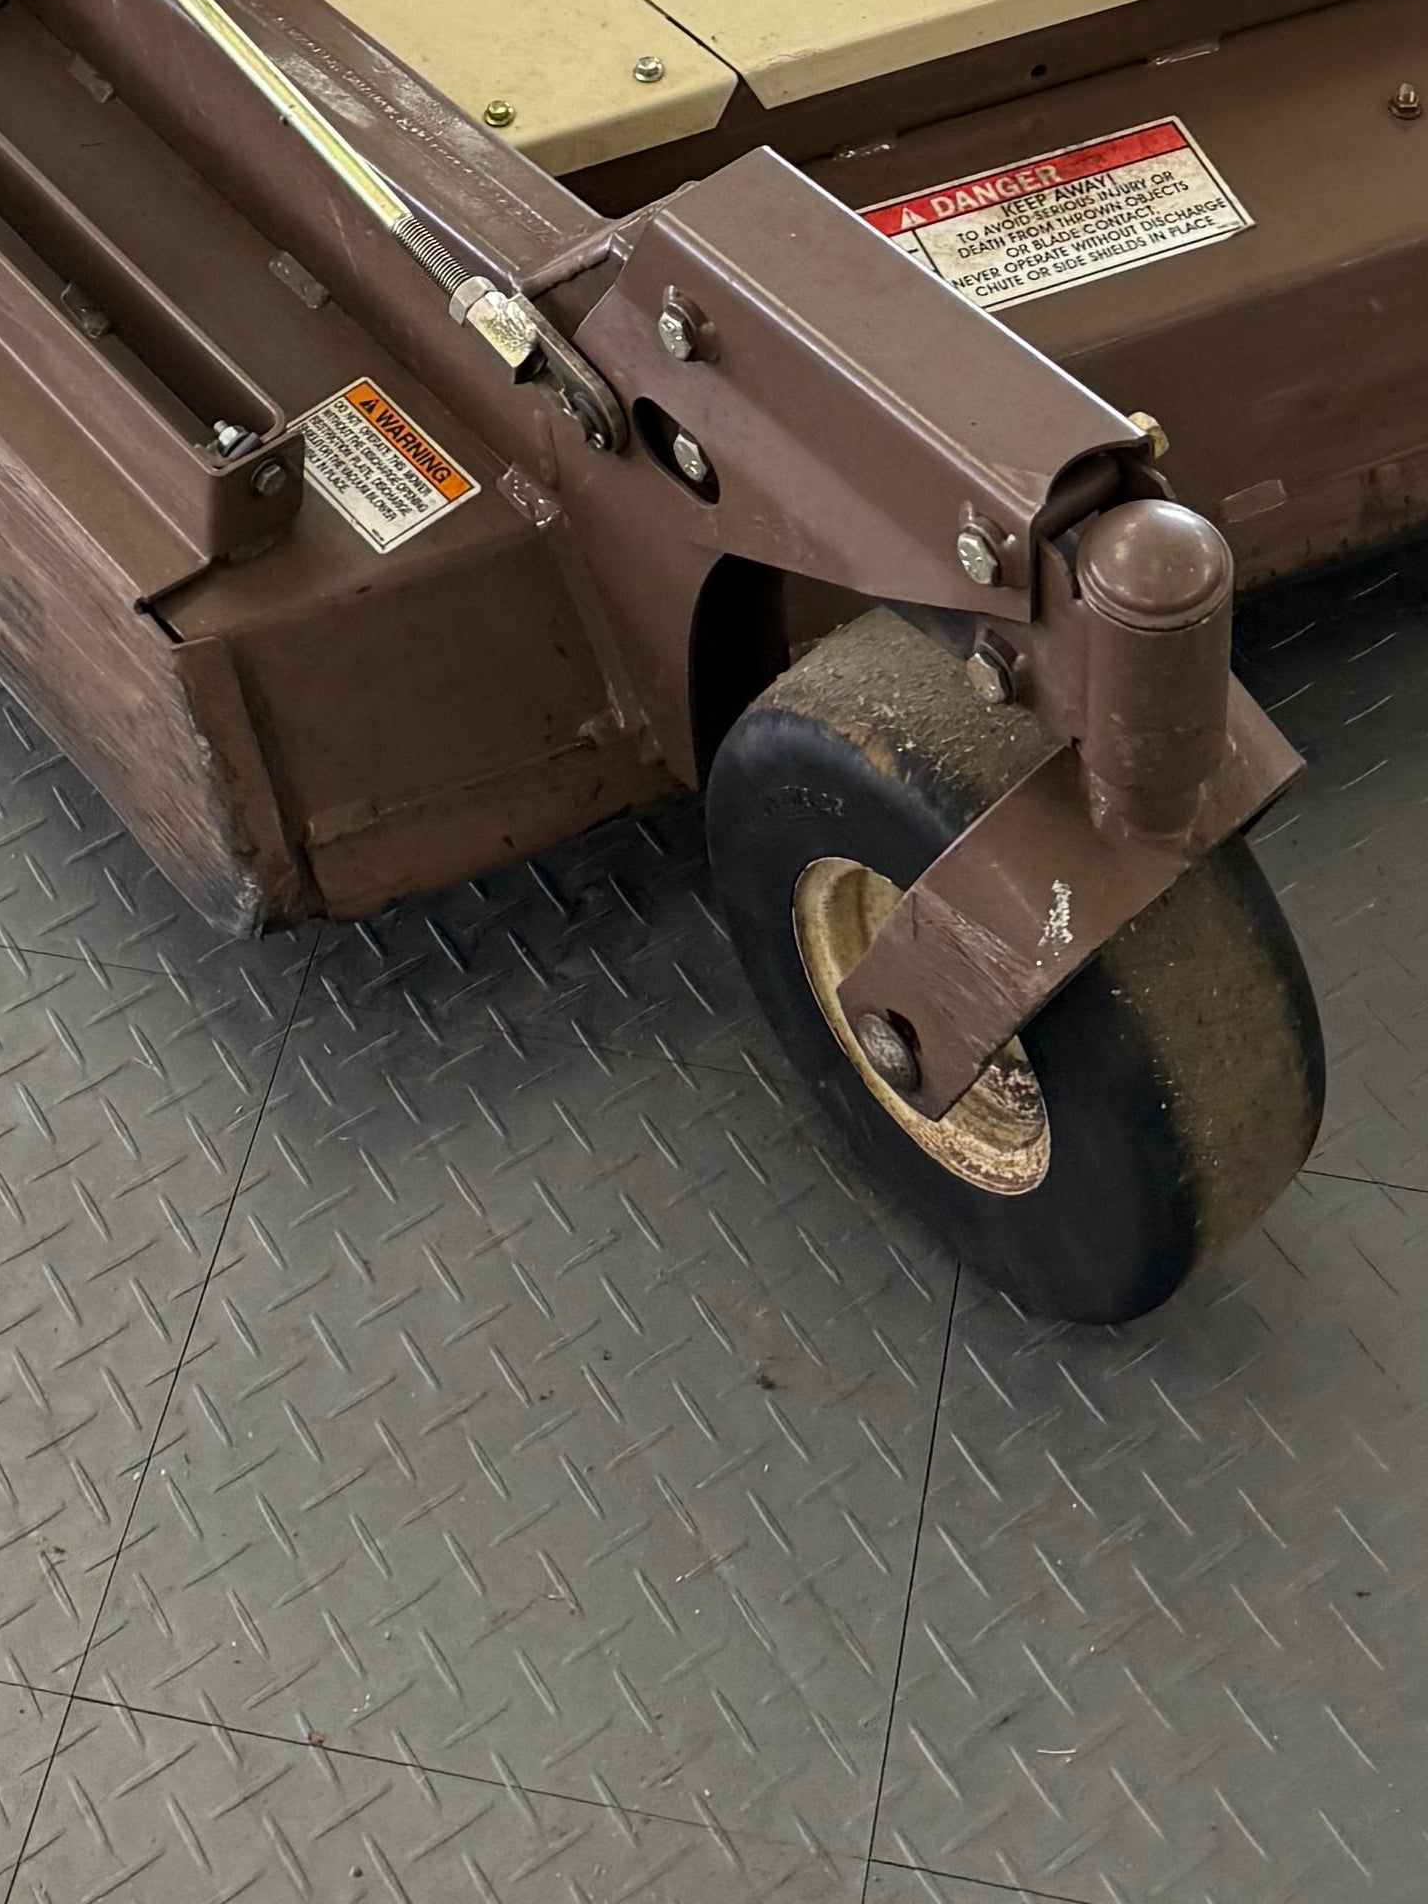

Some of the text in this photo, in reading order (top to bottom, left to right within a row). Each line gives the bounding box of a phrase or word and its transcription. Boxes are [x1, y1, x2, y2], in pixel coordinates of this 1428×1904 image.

[929, 164, 1063, 219] DANGER
[957, 170, 1175, 244] TO AVOID SERIOUS INJURY OR
[957, 180, 1189, 260] DEATH FROM THROWN OBJECTS
[999, 172, 1118, 218] KEEP AWAY!
[951, 196, 1228, 289] NEVER OPERATE WITHOUT DISCHARGE
[975, 274, 1026, 298] CHUTE
[1026, 265, 1052, 281] OR
[1052, 254, 1087, 274] SIDE
[1089, 237, 1149, 264] SHIELDS
[1149, 226, 1167, 244] IN
[1167, 214, 1217, 240] PLACE
[1005, 204, 1161, 258] OR BLADE CONTACT.
[308, 414, 354, 458] RESTRICTION
[370, 475, 413, 517] DISCHARGE
[320, 407, 355, 440] WITHOUT
[346, 433, 366, 450] THE
[359, 445, 403, 486] DISCHARGE
[342, 410, 363, 428] NOT
[357, 425, 392, 457] OPERATE
[386, 453, 407, 472] THIS
[376, 409, 452, 485] WARNING
[364, 490, 398, 522] BLOWER
